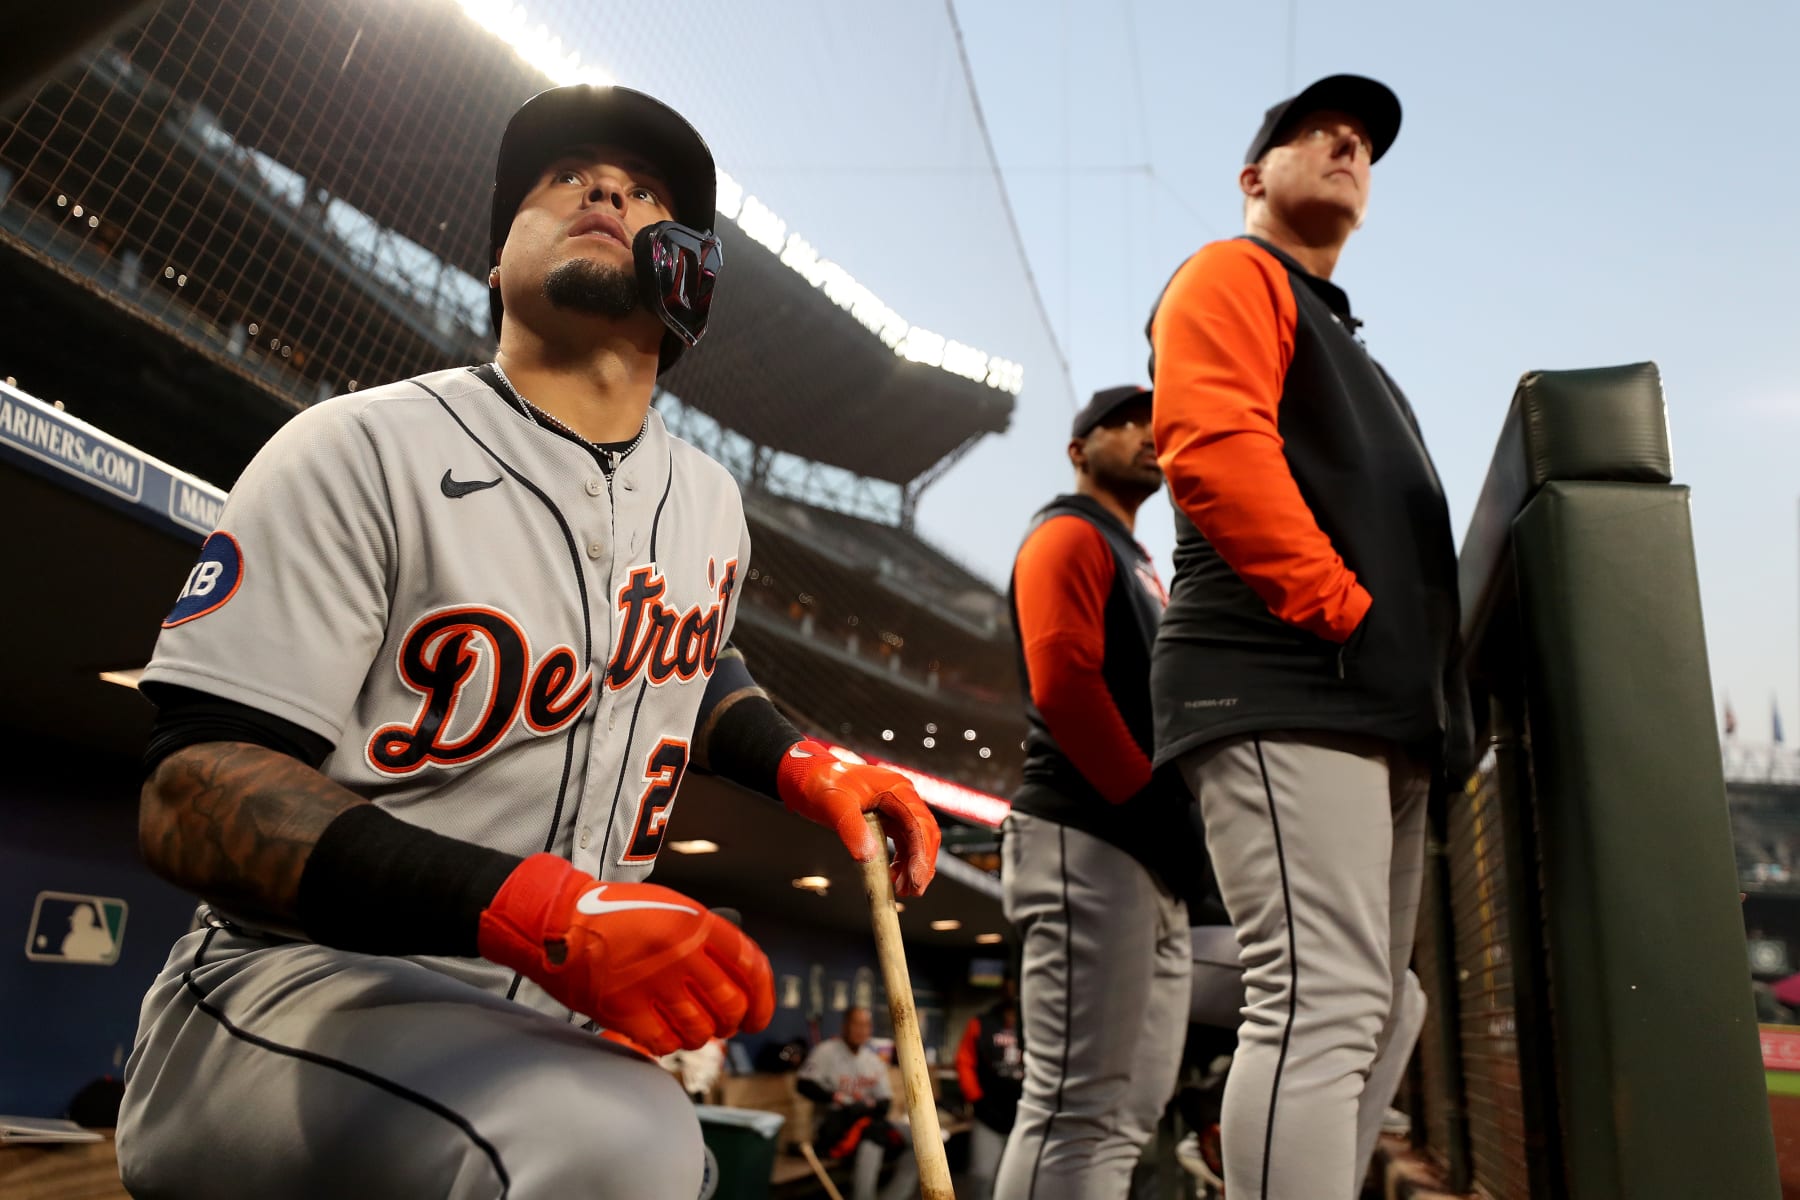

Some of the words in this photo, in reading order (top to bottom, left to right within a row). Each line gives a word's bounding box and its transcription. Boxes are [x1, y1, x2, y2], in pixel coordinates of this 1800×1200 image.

[0, 394, 135, 490] ARINERS.COM
[365, 555, 738, 778] Detroit
[618, 734, 690, 865] 2
